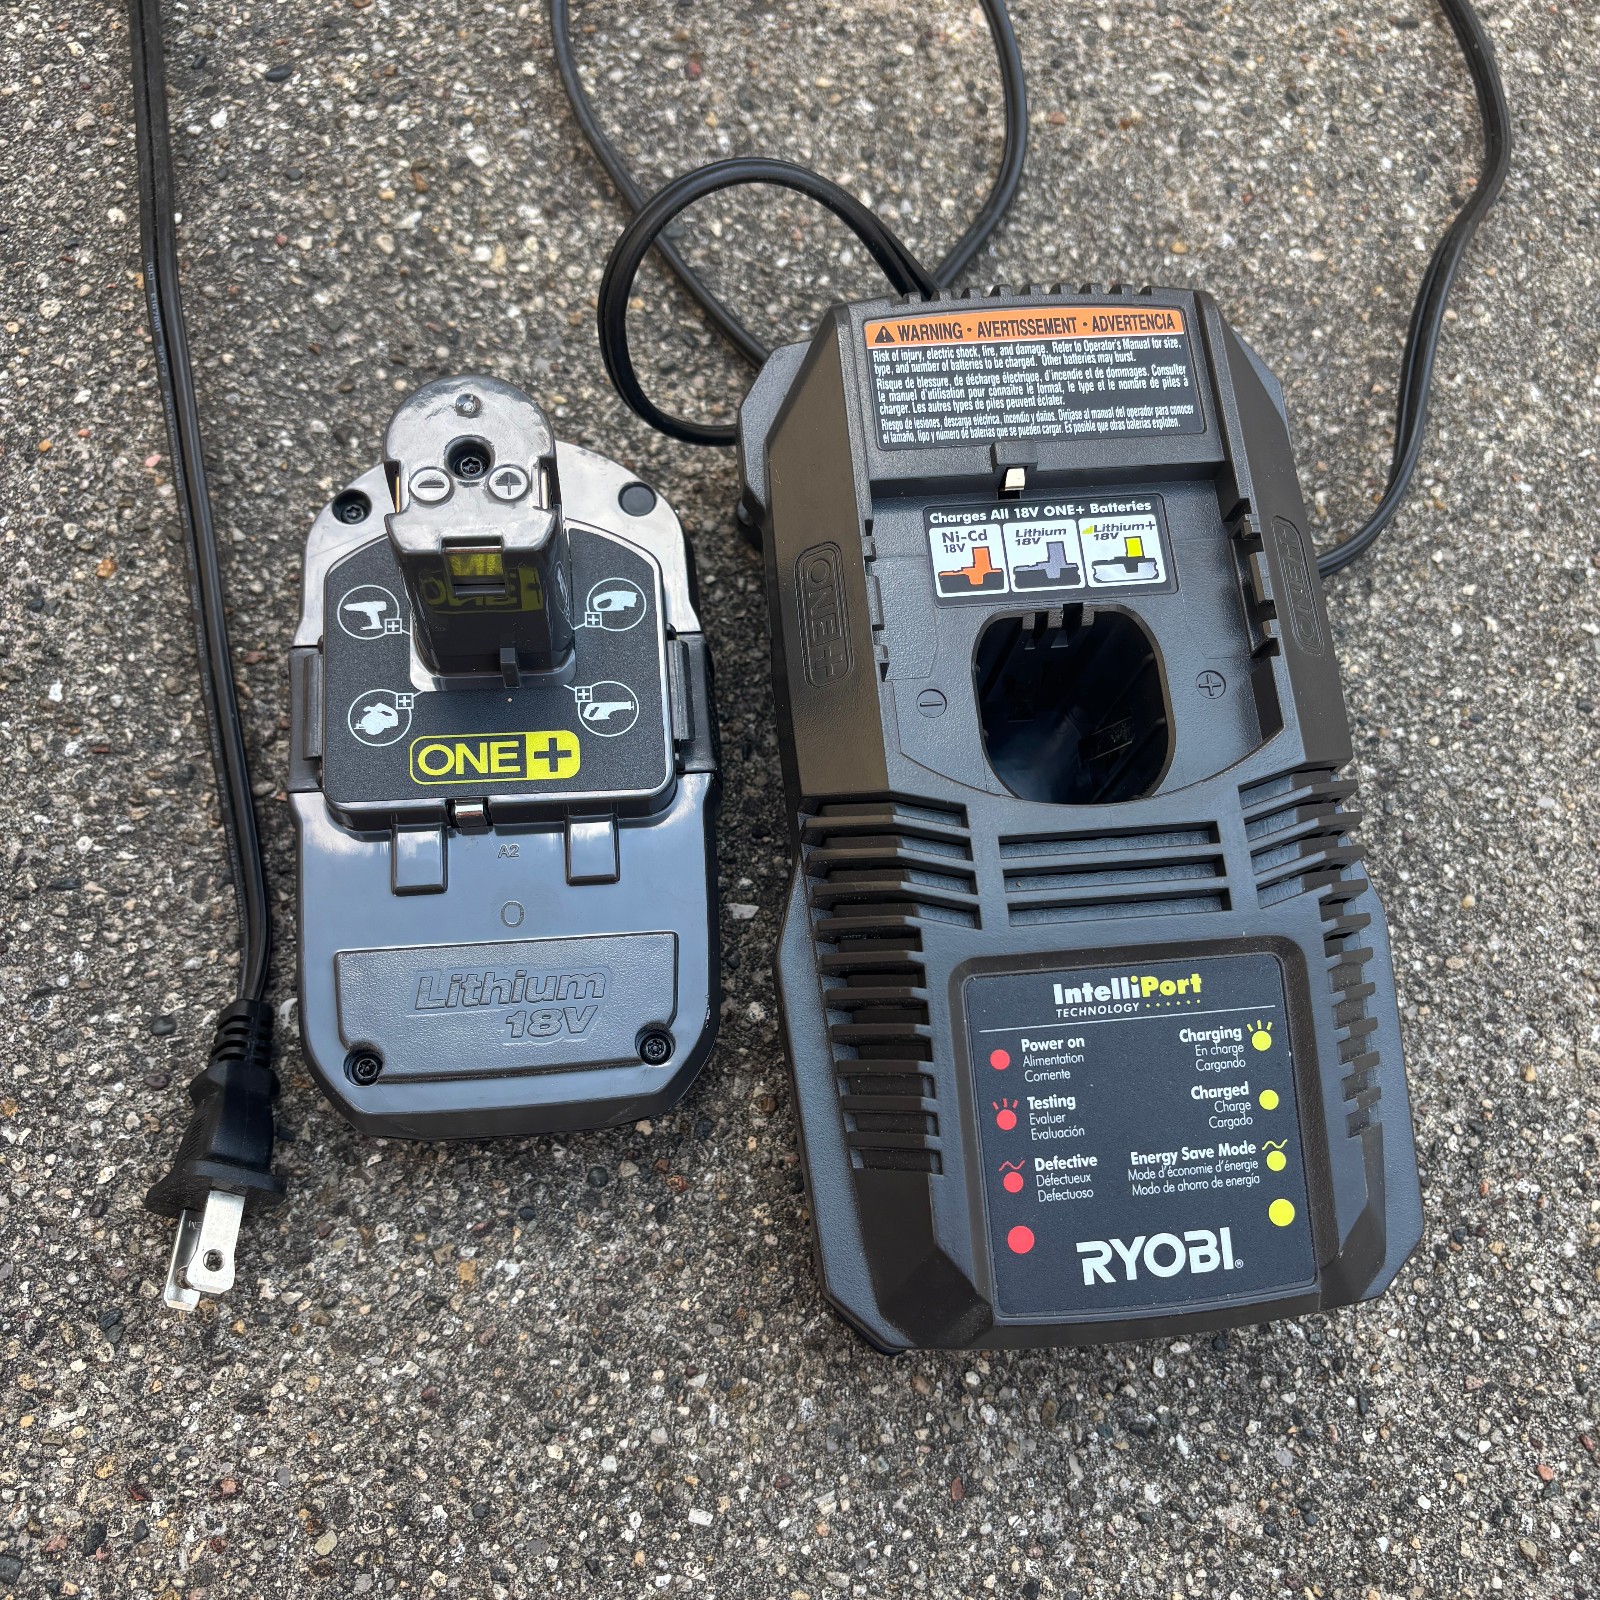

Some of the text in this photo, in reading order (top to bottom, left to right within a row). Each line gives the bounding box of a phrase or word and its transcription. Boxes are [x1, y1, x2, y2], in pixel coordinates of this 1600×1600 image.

[896, 311, 1175, 342] WARNING AVERTISSEMENT ADVERTENCIA
[872, 335, 1181, 363] Risk of injury, electric shock, fire, and damage. Refer to Operator's Manual for size,
[873, 350, 1136, 377] type, and number of batteries to be charged. Other batteries may burst.
[875, 362, 1186, 392] Risque de blessure, de décharge électrique, d'incendie et de dommages. Consulter
[877, 390, 885, 402] le
[888, 389, 917, 401] manuel
[920, 386, 965, 400] d'utilisation
[968, 388, 985, 400] pour
[1026, 383, 1034, 394] le
[1036, 381, 1064, 395] format,
[1067, 380, 1075, 392] le
[1077, 379, 1094, 394] type
[1097, 379, 1105, 391] et
[1107, 378, 1115, 390] le
[1118, 377, 1146, 390] nombre
[1149, 376, 1159, 388] de
[1161, 375, 1180, 390] piles
[1182, 375, 1188, 386] à
[879, 394, 1065, 418] charger. Les autres types de piles peuvent éclater.
[904, 417, 912, 429] de
[943, 414, 972, 429] descarga
[1002, 411, 1029, 424] incendio
[1030, 413, 1035, 424] y
[1083, 407, 1089, 419] al
[1090, 406, 1114, 419] manual
[1115, 405, 1125, 418] del
[1155, 406, 1168, 417] para
[882, 432, 888, 443] el
[917, 430, 930, 443] tipo
[930, 432, 935, 443] y
[960, 427, 969, 439] de
[996, 427, 1008, 439] que
[1009, 427, 1017, 436] se
[1018, 423, 1041, 438] pueden
[1041, 424, 1063, 436] cargar.
[1064, 421, 1072, 433] Es
[1072, 419, 1095, 434] posible
[1096, 421, 1108, 433] que
[1109, 417, 1125, 430] otras
[930, 501, 1151, 525] Charges All 18V ONE+ Batteries
[1016, 527, 1067, 538] Lithium
[1093, 521, 1155, 532] Lithium+
[942, 529, 987, 543] Ni-Cd
[1015, 537, 1041, 546] 18V
[1094, 532, 1119, 540] 18V
[944, 544, 965, 553] 18V
[417, 736, 573, 776] ONE+
[498, 844, 520, 858] A2
[415, 970, 606, 1010] Lithium
[1053, 973, 1202, 1005] IntelliPort
[1056, 1003, 1140, 1018] TECHNOLOGY
[506, 1005, 598, 1038] 18V
[1179, 1026, 1242, 1043] Charging
[1021, 1037, 1085, 1052] Power on
[1195, 1043, 1244, 1058] En charge
[1023, 1052, 1084, 1067] Alimentation
[1196, 1057, 1246, 1072] Cargando
[1024, 1069, 1070, 1082] Corriente
[1191, 1081, 1249, 1101] Charged
[1027, 1094, 1076, 1110] Testing
[1214, 1099, 1251, 1115] Charge
[1029, 1112, 1066, 1125] Evaluer
[1209, 1114, 1253, 1131] Cargado
[1031, 1125, 1085, 1141] Evaluación
[1131, 1140, 1256, 1166] Energy Save Mode
[1034, 1154, 1097, 1171] Defective
[1128, 1158, 1258, 1181] Mode d'économie d'énergie
[1036, 1172, 1091, 1187] Défectueux
[1132, 1173, 1260, 1196] Modo de ahorro de energía
[1038, 1187, 1094, 1202] Defectuoso
